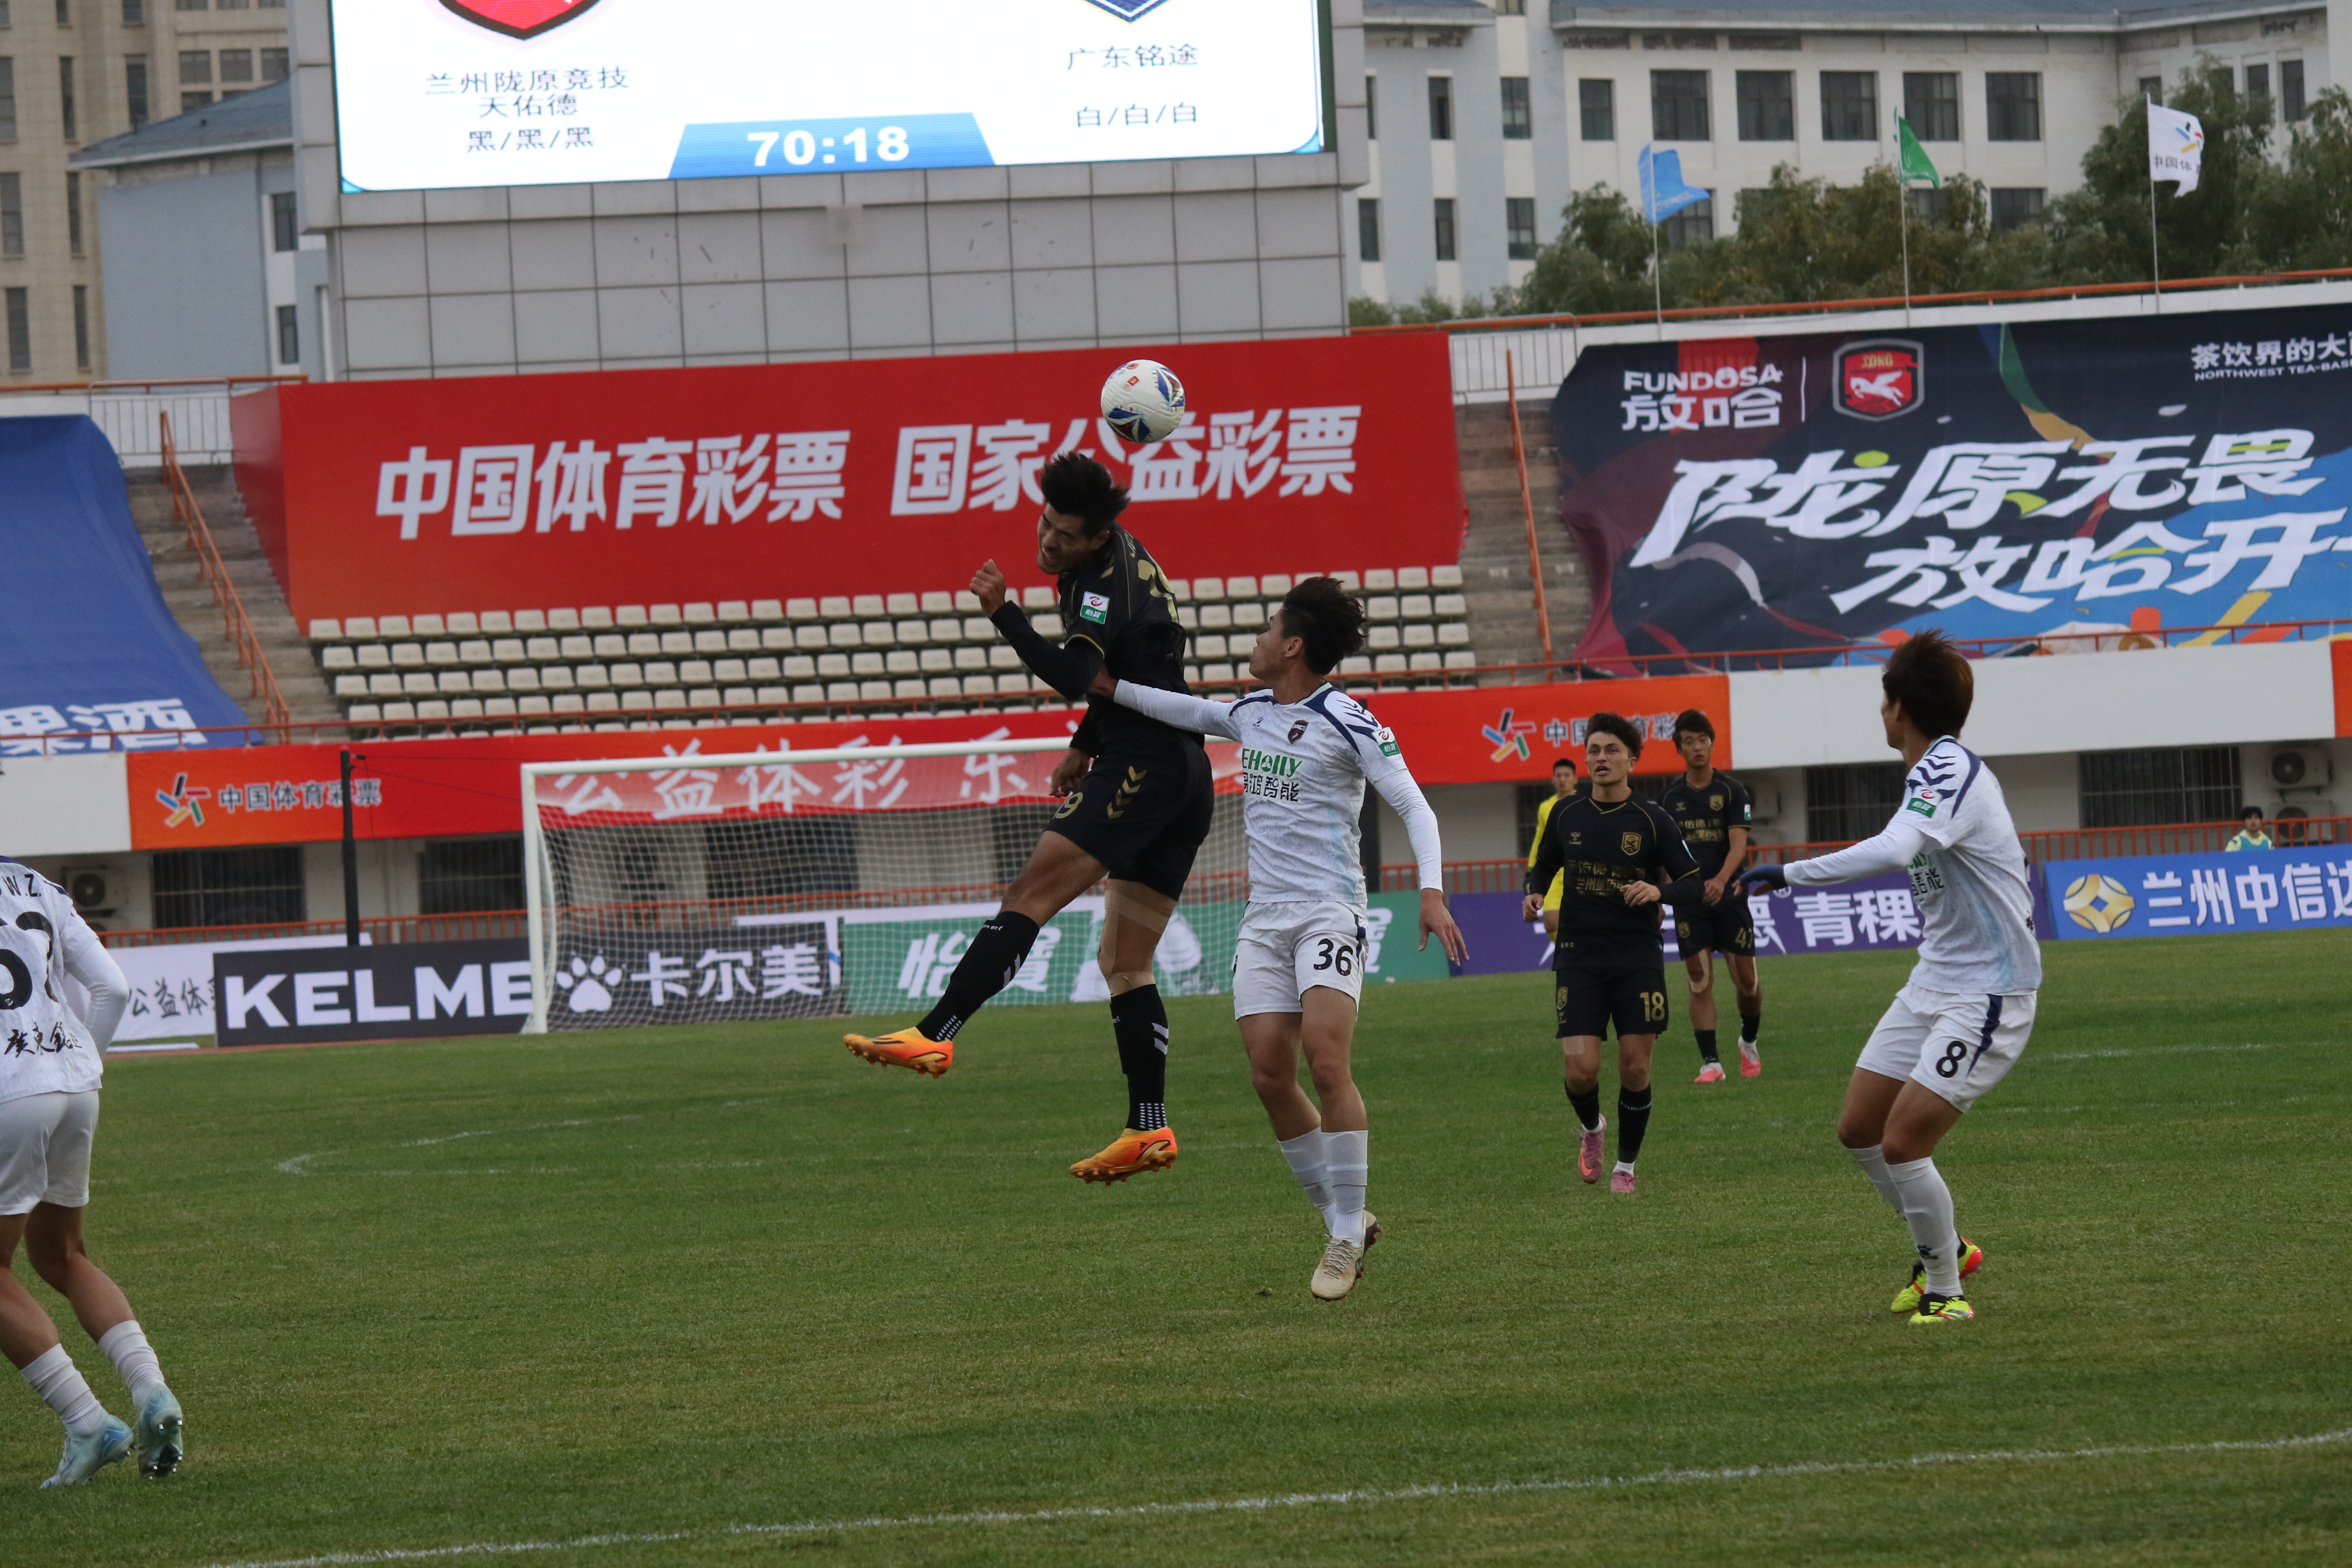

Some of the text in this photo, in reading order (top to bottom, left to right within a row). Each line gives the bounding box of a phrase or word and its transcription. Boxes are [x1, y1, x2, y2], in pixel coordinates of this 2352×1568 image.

[1068, 43, 1198, 70] 广东铭途
[426, 66, 629, 96] 兰州陇原竞技
[479, 93, 579, 119] 天佑德
[1077, 102, 1197, 128] 白/白/白
[466, 126, 595, 153] 黑/黑/黑
[747, 127, 910, 167] 70:18
[2192, 331, 2352, 370] 茶饮界的大
[1624, 363, 1783, 392] FUNDOSA
[2194, 367, 2285, 382] NORTHWEST
[376, 430, 851, 540] 中国体育彩票
[1630, 430, 2328, 568] 陇原无畏
[1829, 505, 2352, 613] 放哈开
[630, 942, 822, 1006] 卡尔美
[1314, 938, 1354, 976] 36
[128, 977, 215, 1019] 公益体
[224, 960, 533, 1030] KELME
[1640, 992, 1666, 1022] 18
[1936, 1040, 1967, 1078] 8
